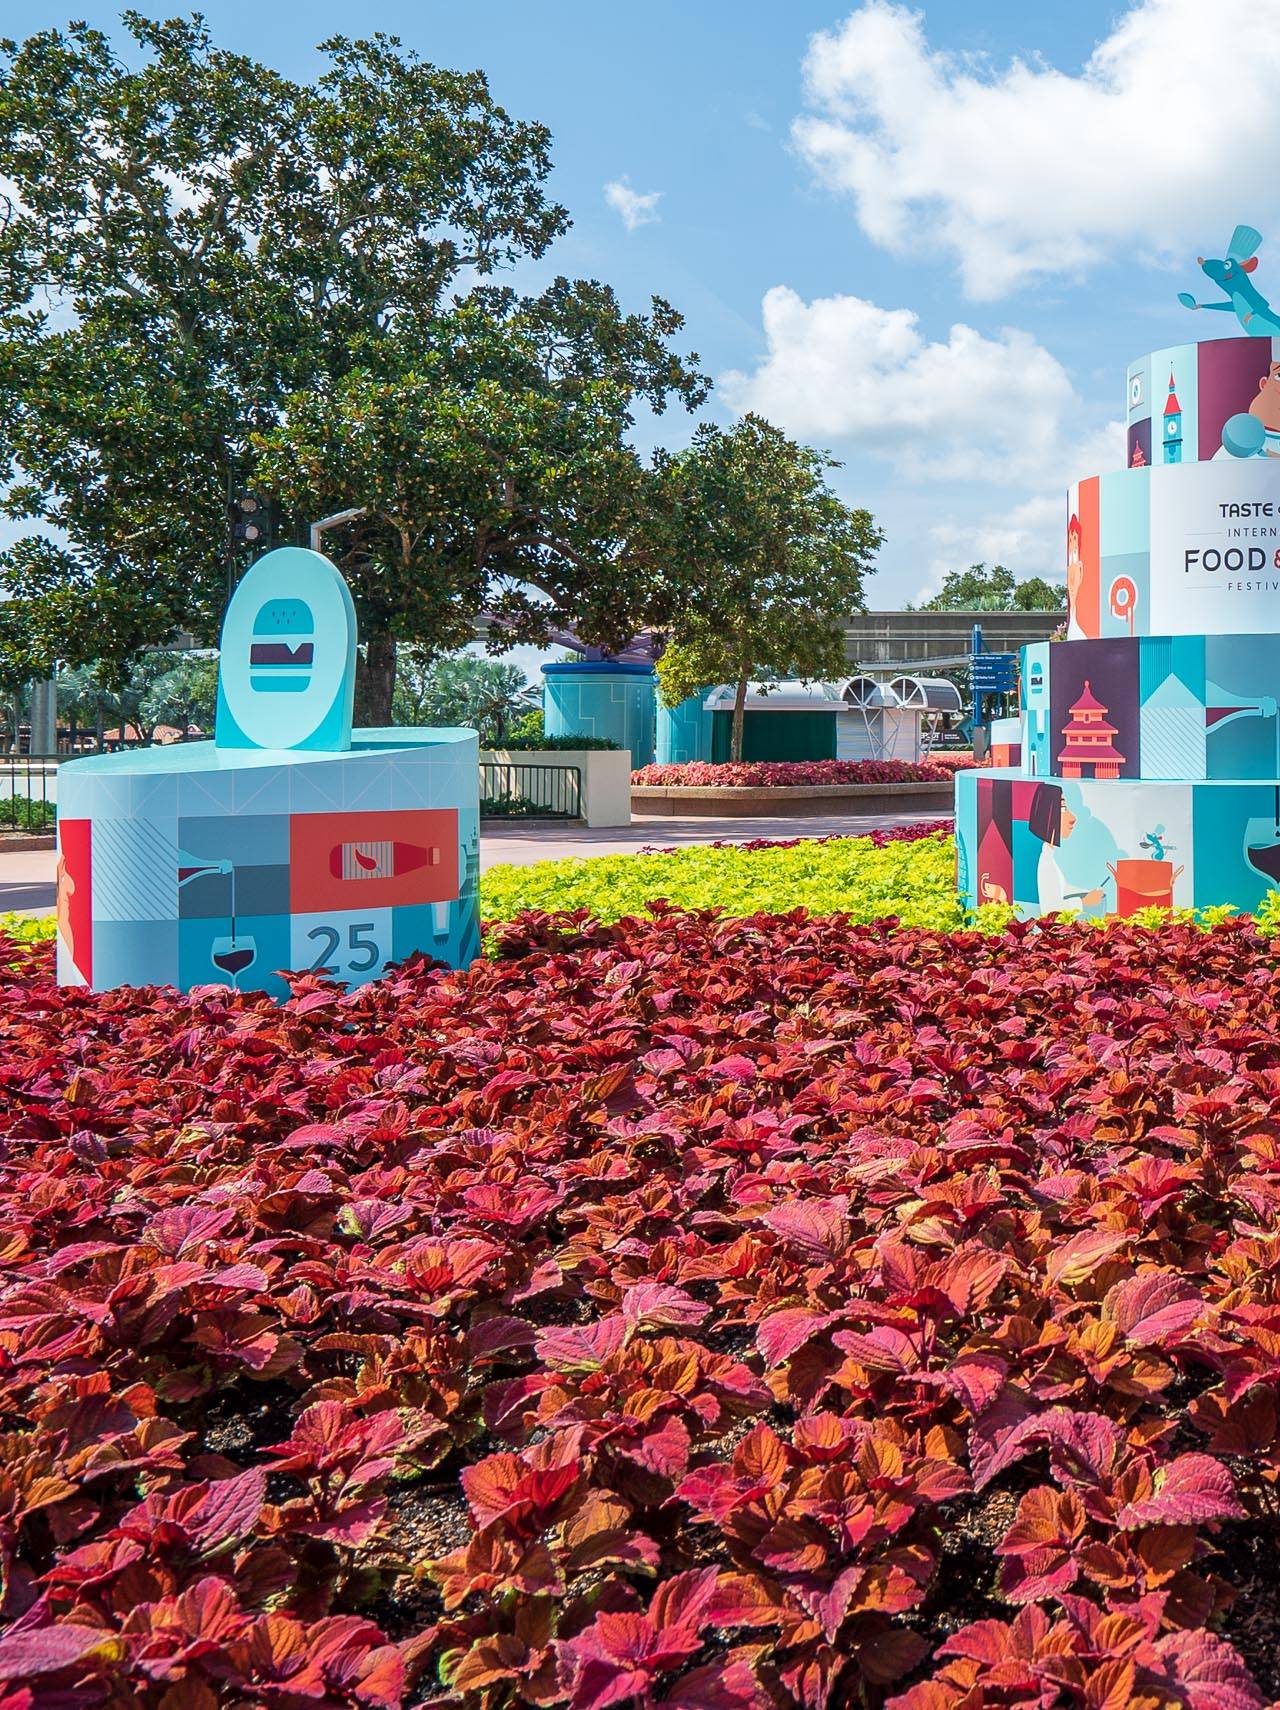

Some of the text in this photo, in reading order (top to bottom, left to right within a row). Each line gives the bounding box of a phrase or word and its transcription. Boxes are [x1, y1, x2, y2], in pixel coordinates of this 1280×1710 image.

[1219, 503, 1273, 518] TASTE
[1184, 547, 1266, 573] FOOD
[307, 923, 380, 976] 25
